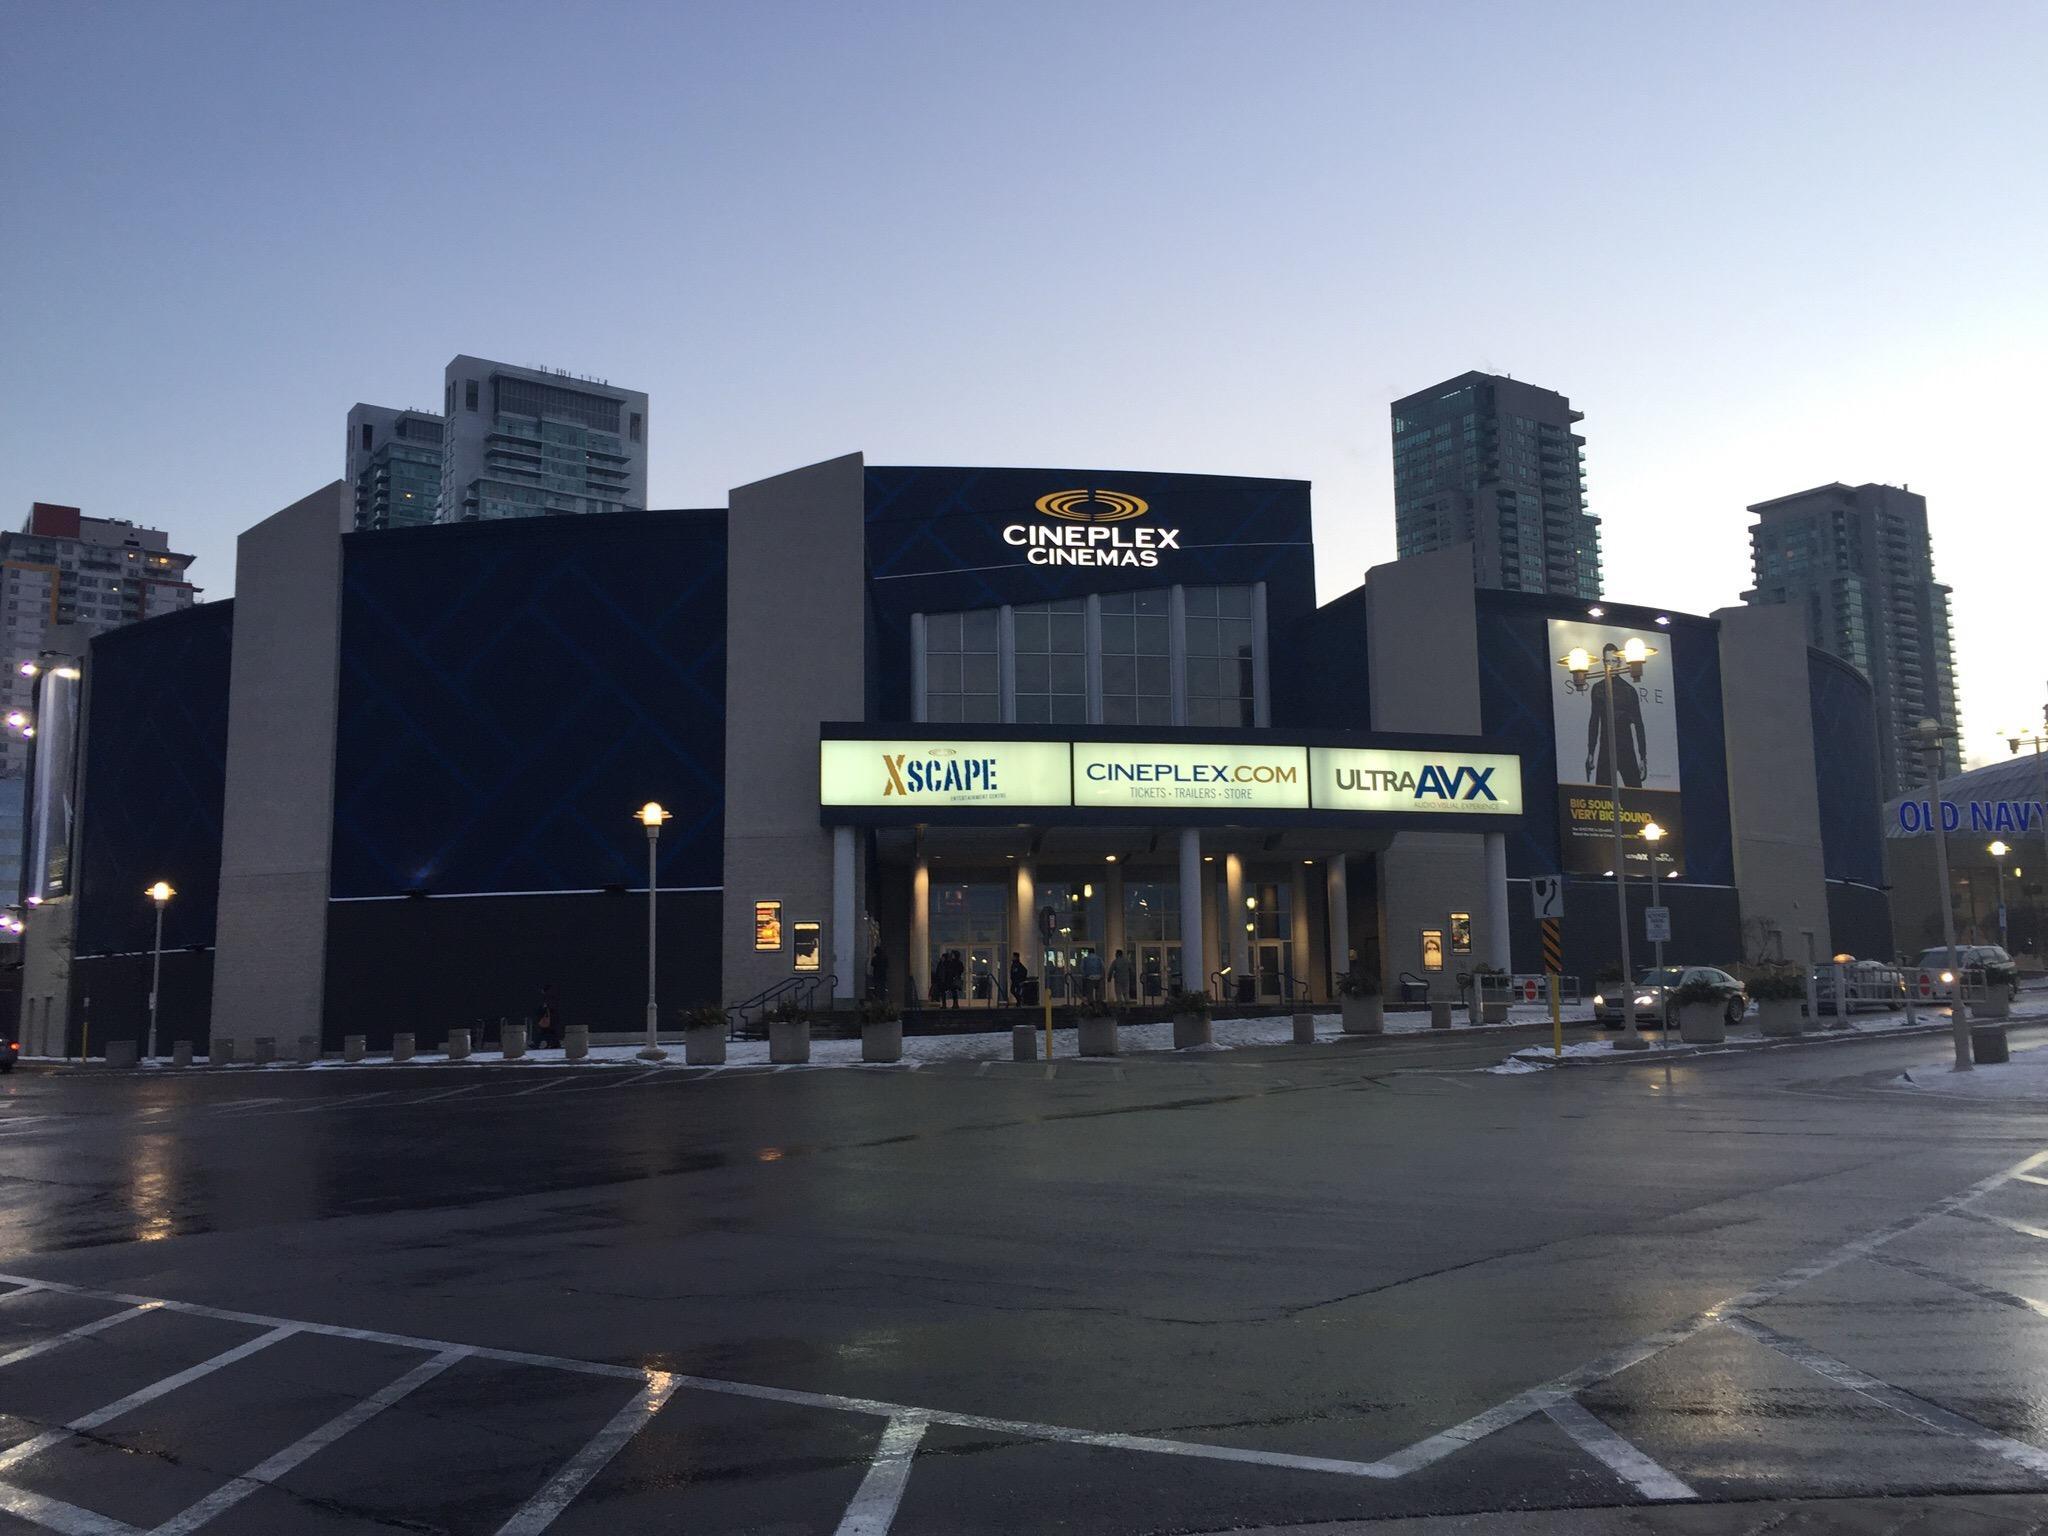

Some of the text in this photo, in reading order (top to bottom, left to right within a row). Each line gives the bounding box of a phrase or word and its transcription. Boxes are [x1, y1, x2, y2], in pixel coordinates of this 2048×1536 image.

[1003, 525, 1180, 549] CINEPLEX
[1027, 548, 1159, 567] CINEMAS
[1564, 679, 1663, 704] SPRE
[883, 754, 998, 796] XSCAPE
[1086, 763, 1297, 784] CINEPLEX.COM
[1130, 787, 1253, 800] TICKETS TRAILERS STORE
[1570, 799, 1586, 808] BIG
[1570, 809, 1597, 820] VERY
[1599, 811, 1614, 820] BIG
[1900, 801, 1960, 832] OLD
